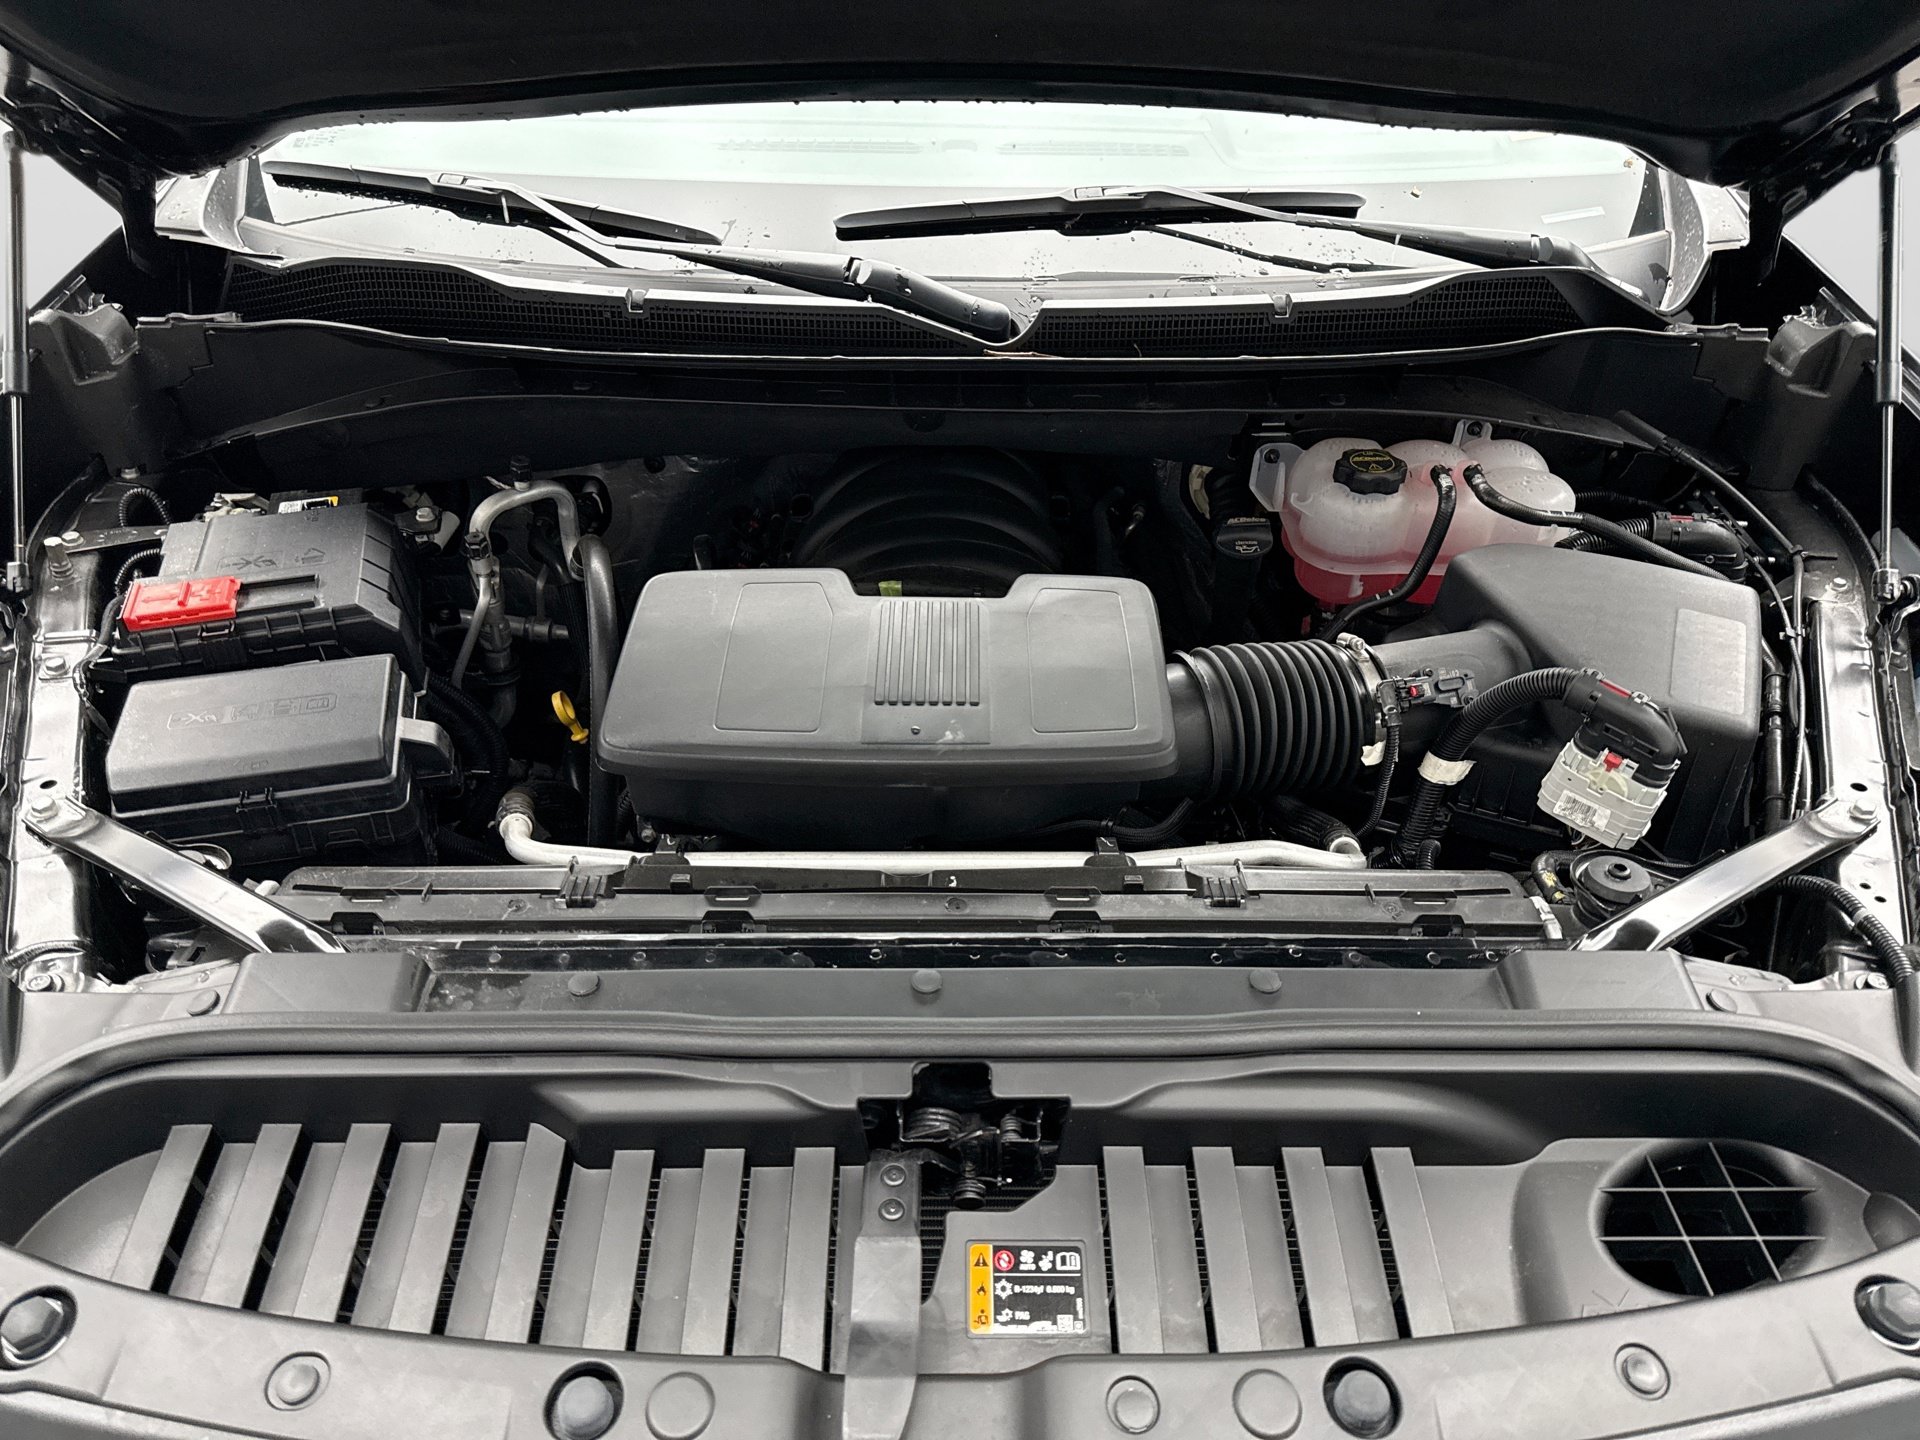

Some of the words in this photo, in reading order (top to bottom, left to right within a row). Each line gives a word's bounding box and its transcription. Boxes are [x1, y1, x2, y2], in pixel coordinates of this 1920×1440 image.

[1227, 517, 1266, 525] ACDelco
[1019, 1263, 1036, 1271] AUTO
[1065, 1285, 1075, 1295] kg
